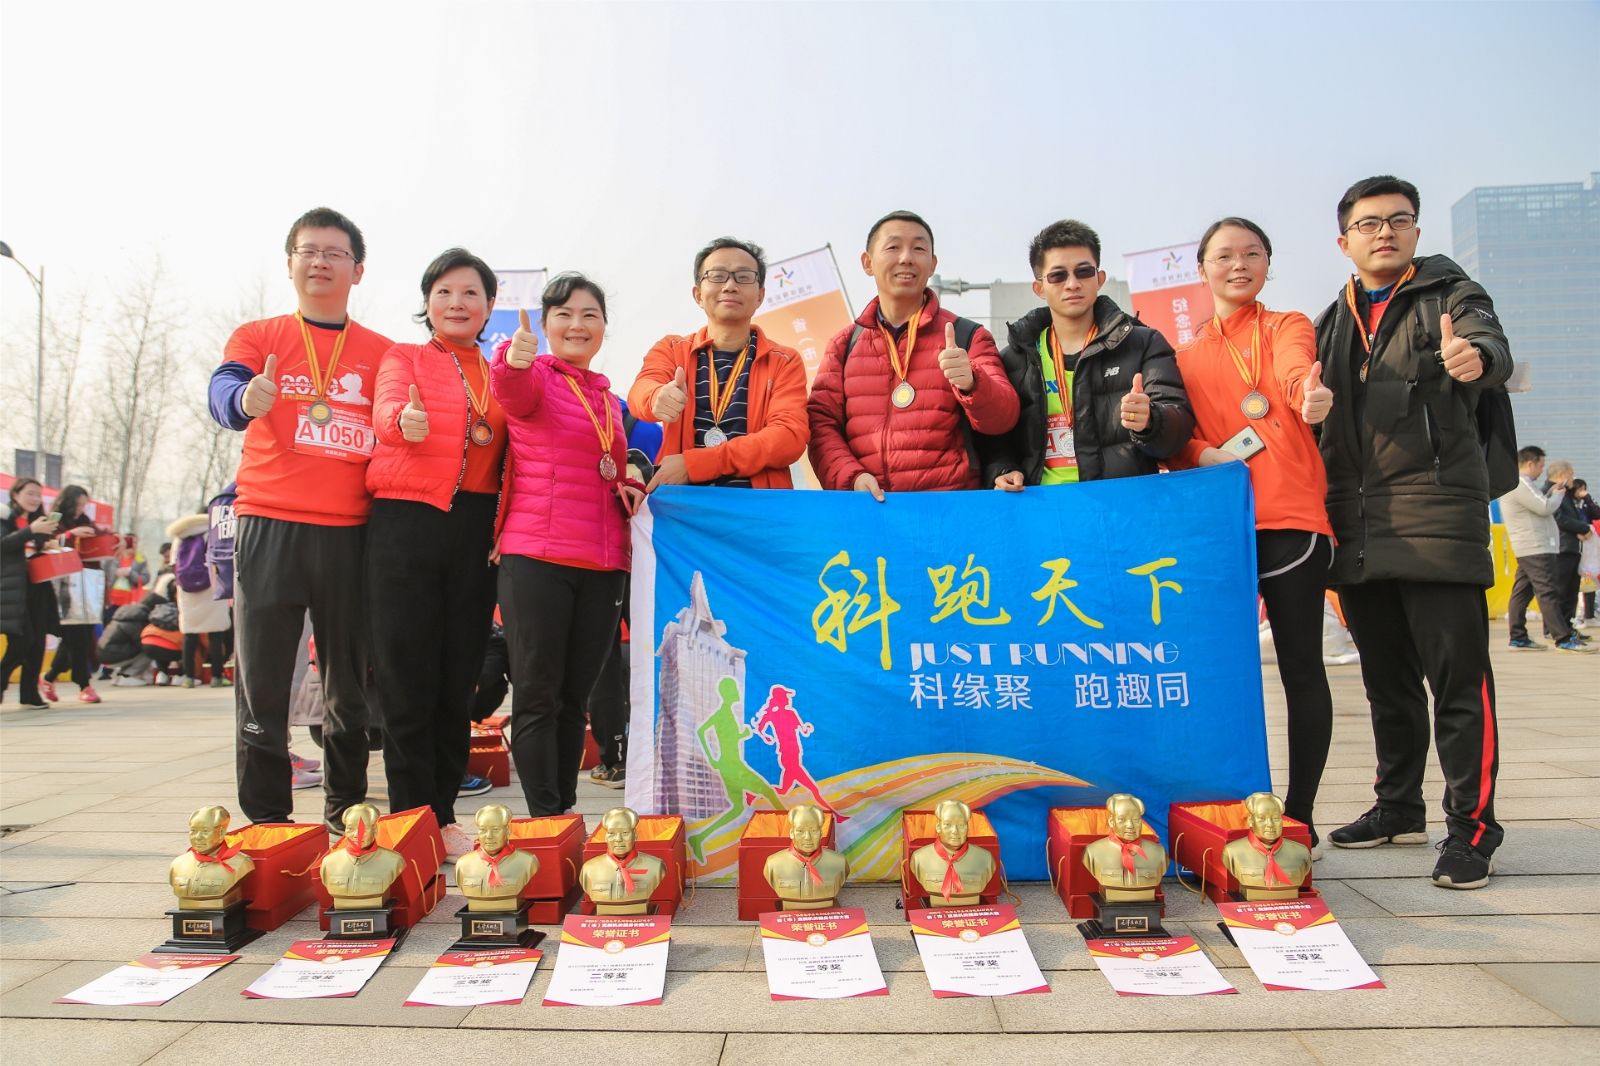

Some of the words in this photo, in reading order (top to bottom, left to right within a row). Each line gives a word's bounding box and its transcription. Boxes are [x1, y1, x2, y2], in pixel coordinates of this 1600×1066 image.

[298, 420, 365, 449] A1050
[811, 549, 1184, 671] 科跑天下
[909, 642, 997, 671] JUST
[1009, 641, 1180, 666] RUNNING
[909, 673, 1034, 711] 科缘聚
[1074, 672, 1191, 711] 跑趣同
[1253, 911, 1302, 922] 荣誉证书
[790, 921, 838, 932] 荣誉证书
[941, 918, 989, 929] 荣誉证书
[592, 929, 640, 938] 荣誉证书
[805, 963, 842, 972] 二等奖
[590, 972, 628, 980] 二等奖
